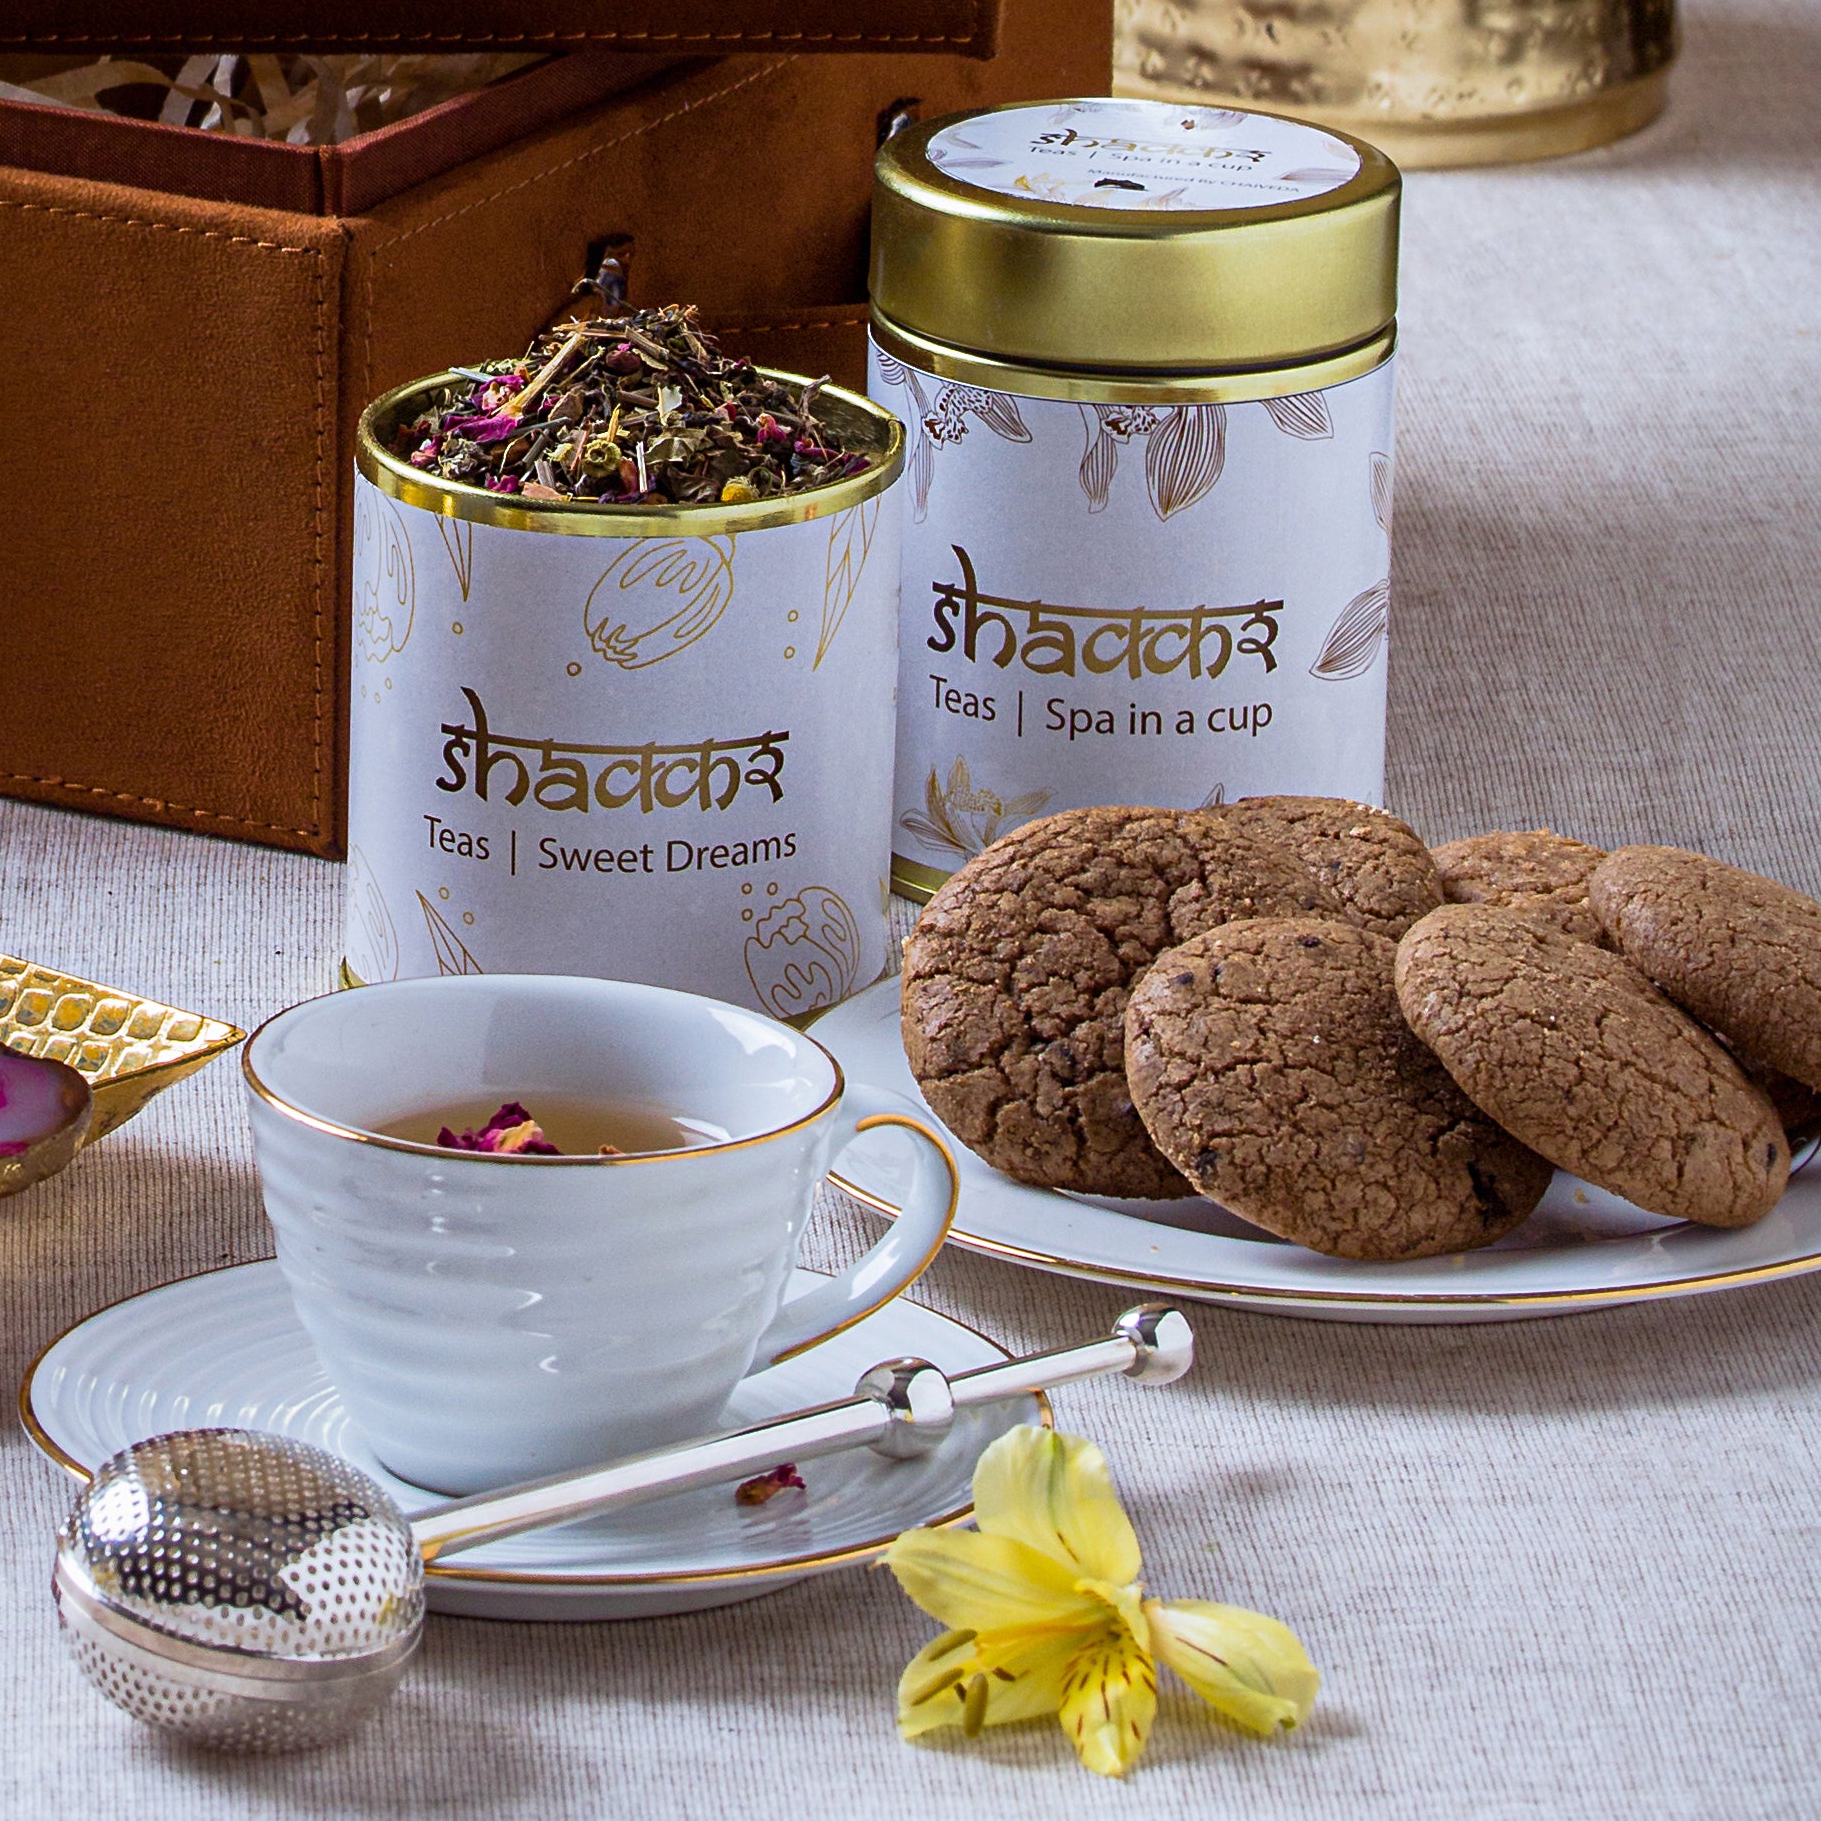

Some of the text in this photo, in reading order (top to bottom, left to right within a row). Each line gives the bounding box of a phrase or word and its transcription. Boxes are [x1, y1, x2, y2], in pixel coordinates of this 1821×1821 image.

[1030, 145, 1077, 156] Teas
[1159, 157, 1180, 166] in
[1208, 162, 1253, 172] cup
[930, 674, 996, 722] Teas
[1045, 697, 1115, 741] Spa
[1129, 702, 1162, 735] in
[1175, 706, 1195, 735] a
[1207, 701, 1273, 737] cup
[423, 814, 491, 861] Teas
[539, 837, 654, 874] Sweet
[666, 832, 797, 873] Dreams
